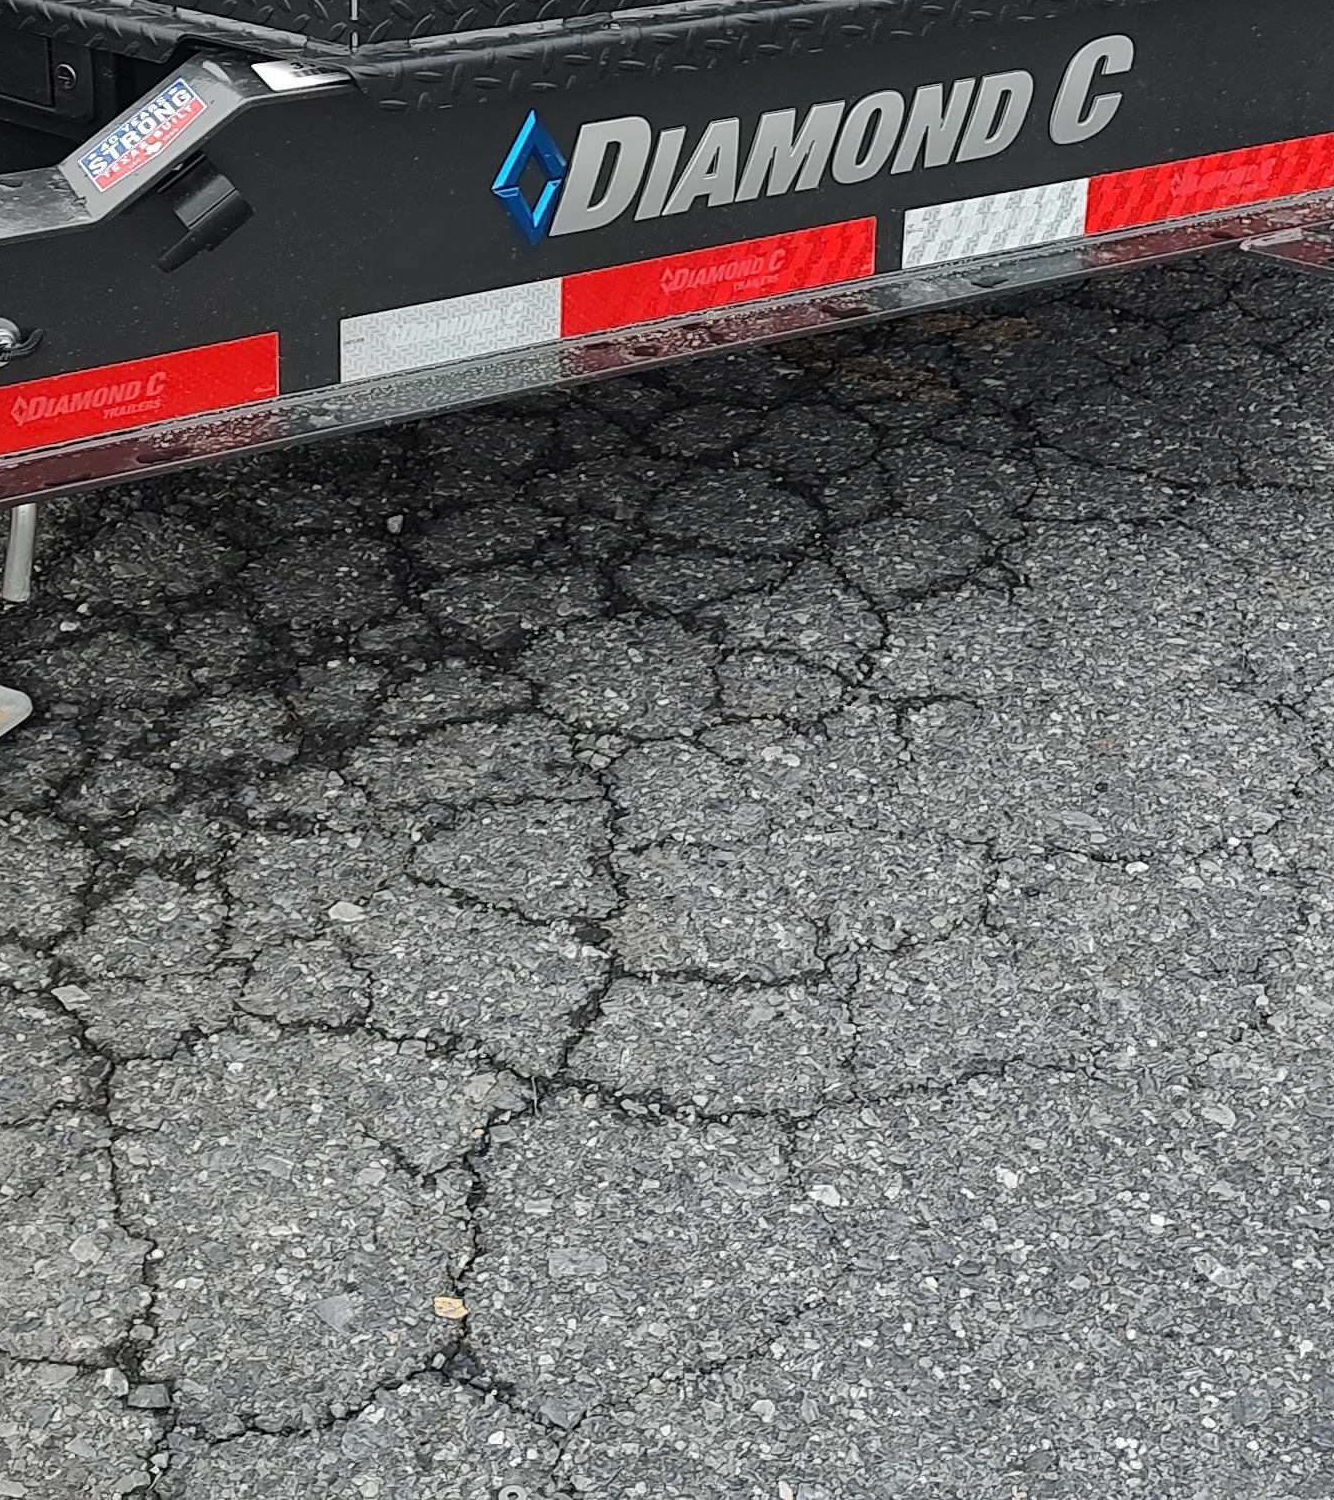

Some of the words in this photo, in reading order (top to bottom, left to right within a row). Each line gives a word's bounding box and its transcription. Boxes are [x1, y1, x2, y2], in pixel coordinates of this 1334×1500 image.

[88, 89, 192, 176] STRONG
[100, 134, 120, 152] 40
[121, 97, 167, 132] YEARS
[102, 140, 148, 179] TEXAS
[152, 104, 193, 139] BUILT
[548, 68, 1034, 237] DIAMOND
[1049, 34, 1134, 145] C
[670, 256, 764, 292] DIAMOND
[768, 248, 786, 271] C
[26, 380, 143, 422] DIAMOND
[145, 372, 167, 397] C
[102, 398, 162, 420] TRAILERS
